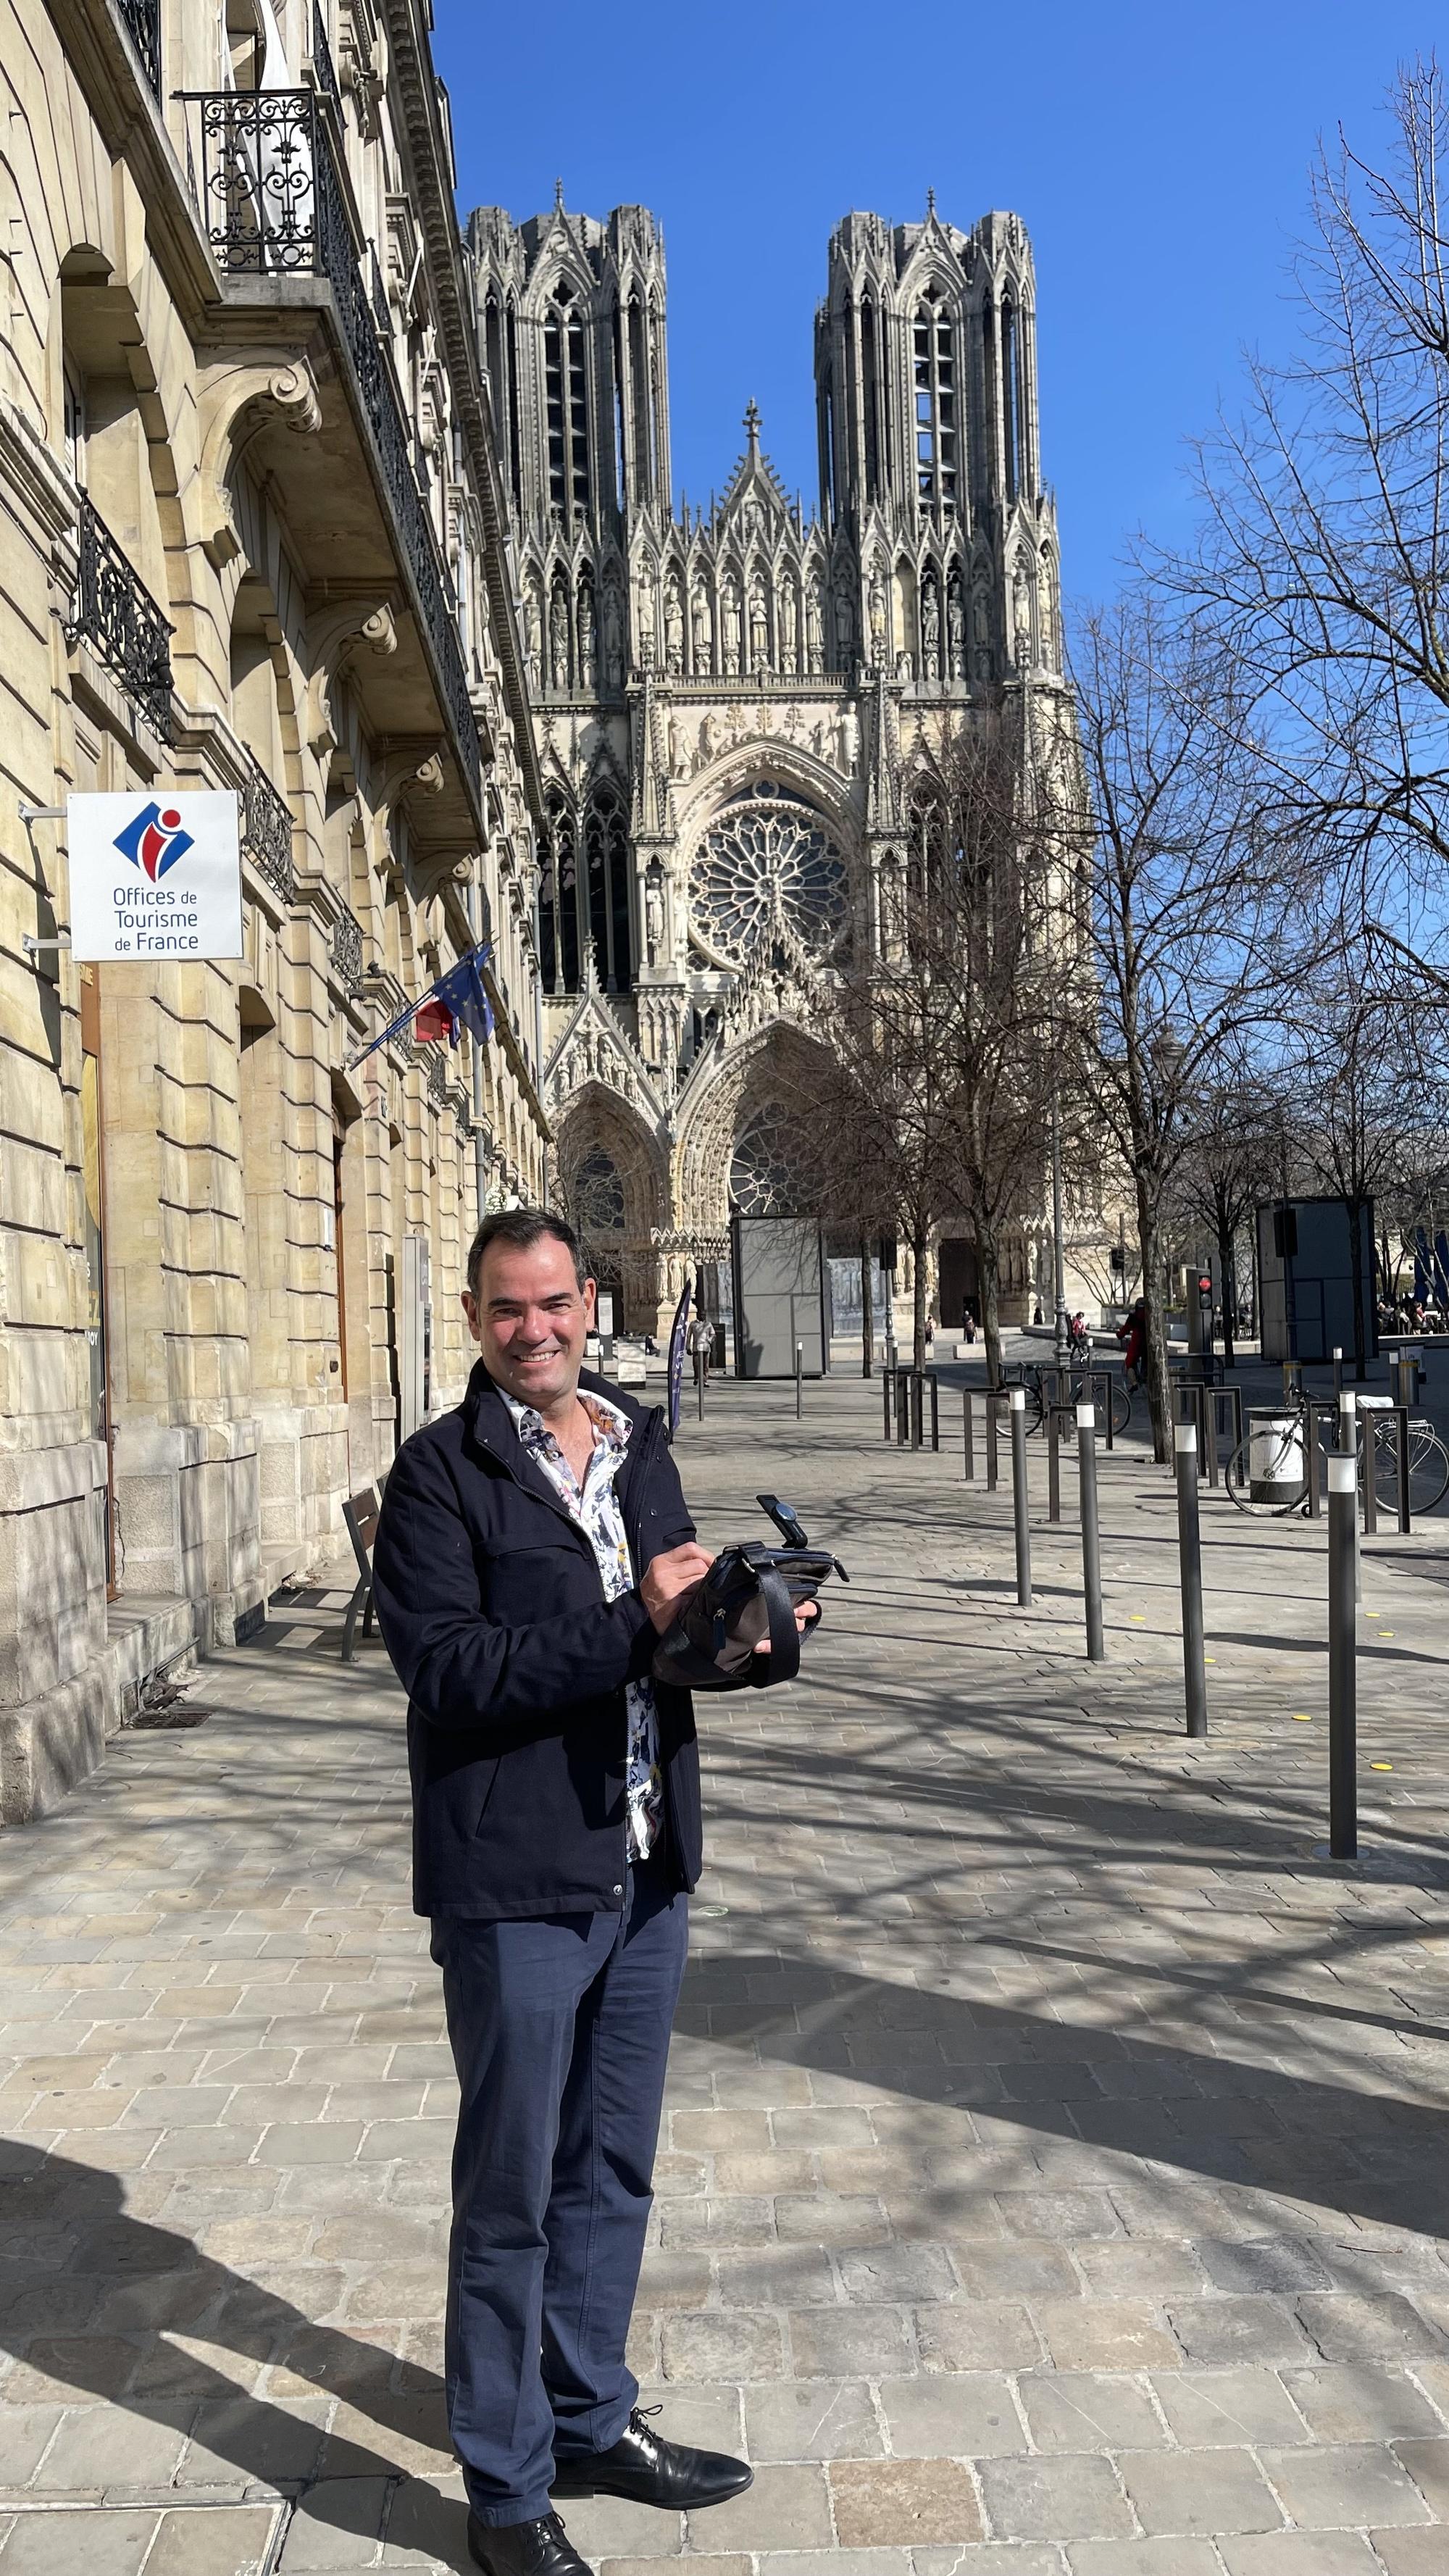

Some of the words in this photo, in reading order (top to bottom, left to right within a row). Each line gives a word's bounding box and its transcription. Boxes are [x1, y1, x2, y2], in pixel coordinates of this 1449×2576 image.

[113, 887, 175, 906] Offices
[180, 891, 198, 904] de
[114, 909, 198, 928] Tourisme
[114, 938, 131, 951] de
[137, 932, 199, 951] France
